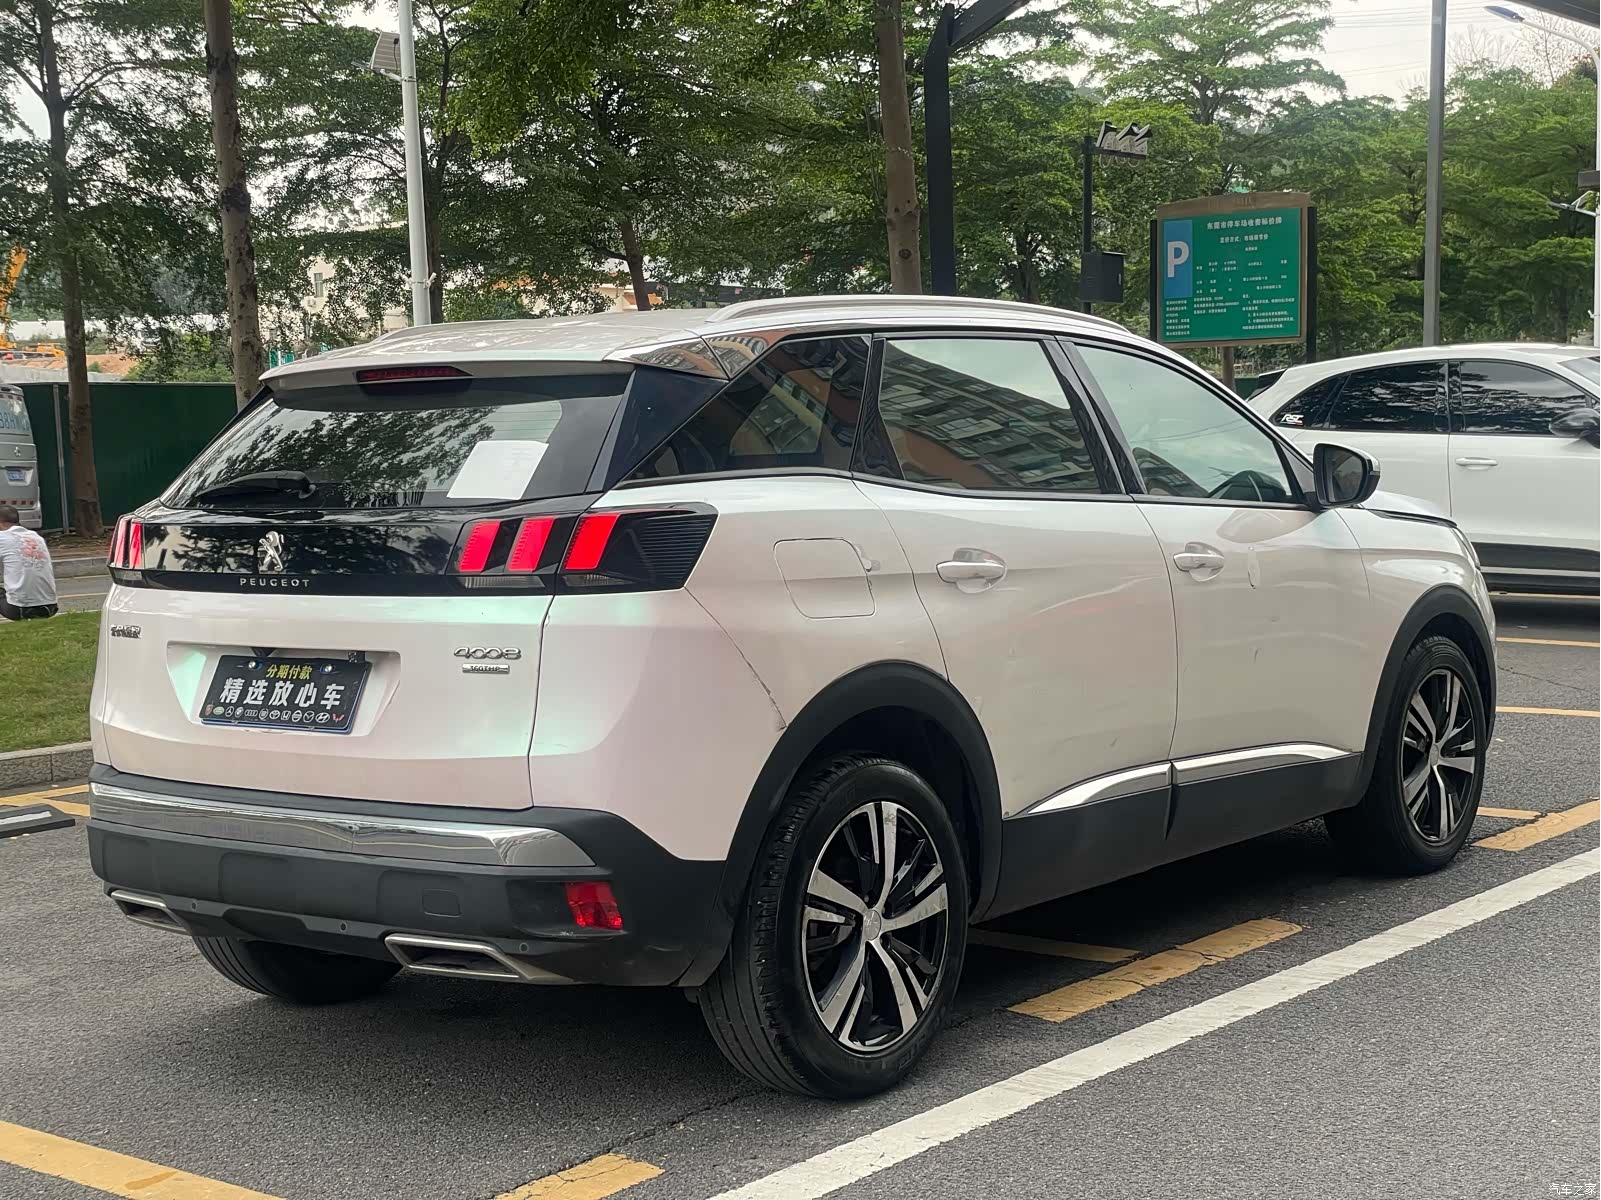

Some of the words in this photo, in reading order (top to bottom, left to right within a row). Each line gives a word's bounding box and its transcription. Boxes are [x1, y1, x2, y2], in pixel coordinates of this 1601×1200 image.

[1167, 241, 1189, 278] P
[239, 578, 310, 587] PEUGEOT
[453, 647, 522, 660] 4008
[265, 664, 313, 680] 分期付款
[219, 677, 345, 710] 精选放心车
